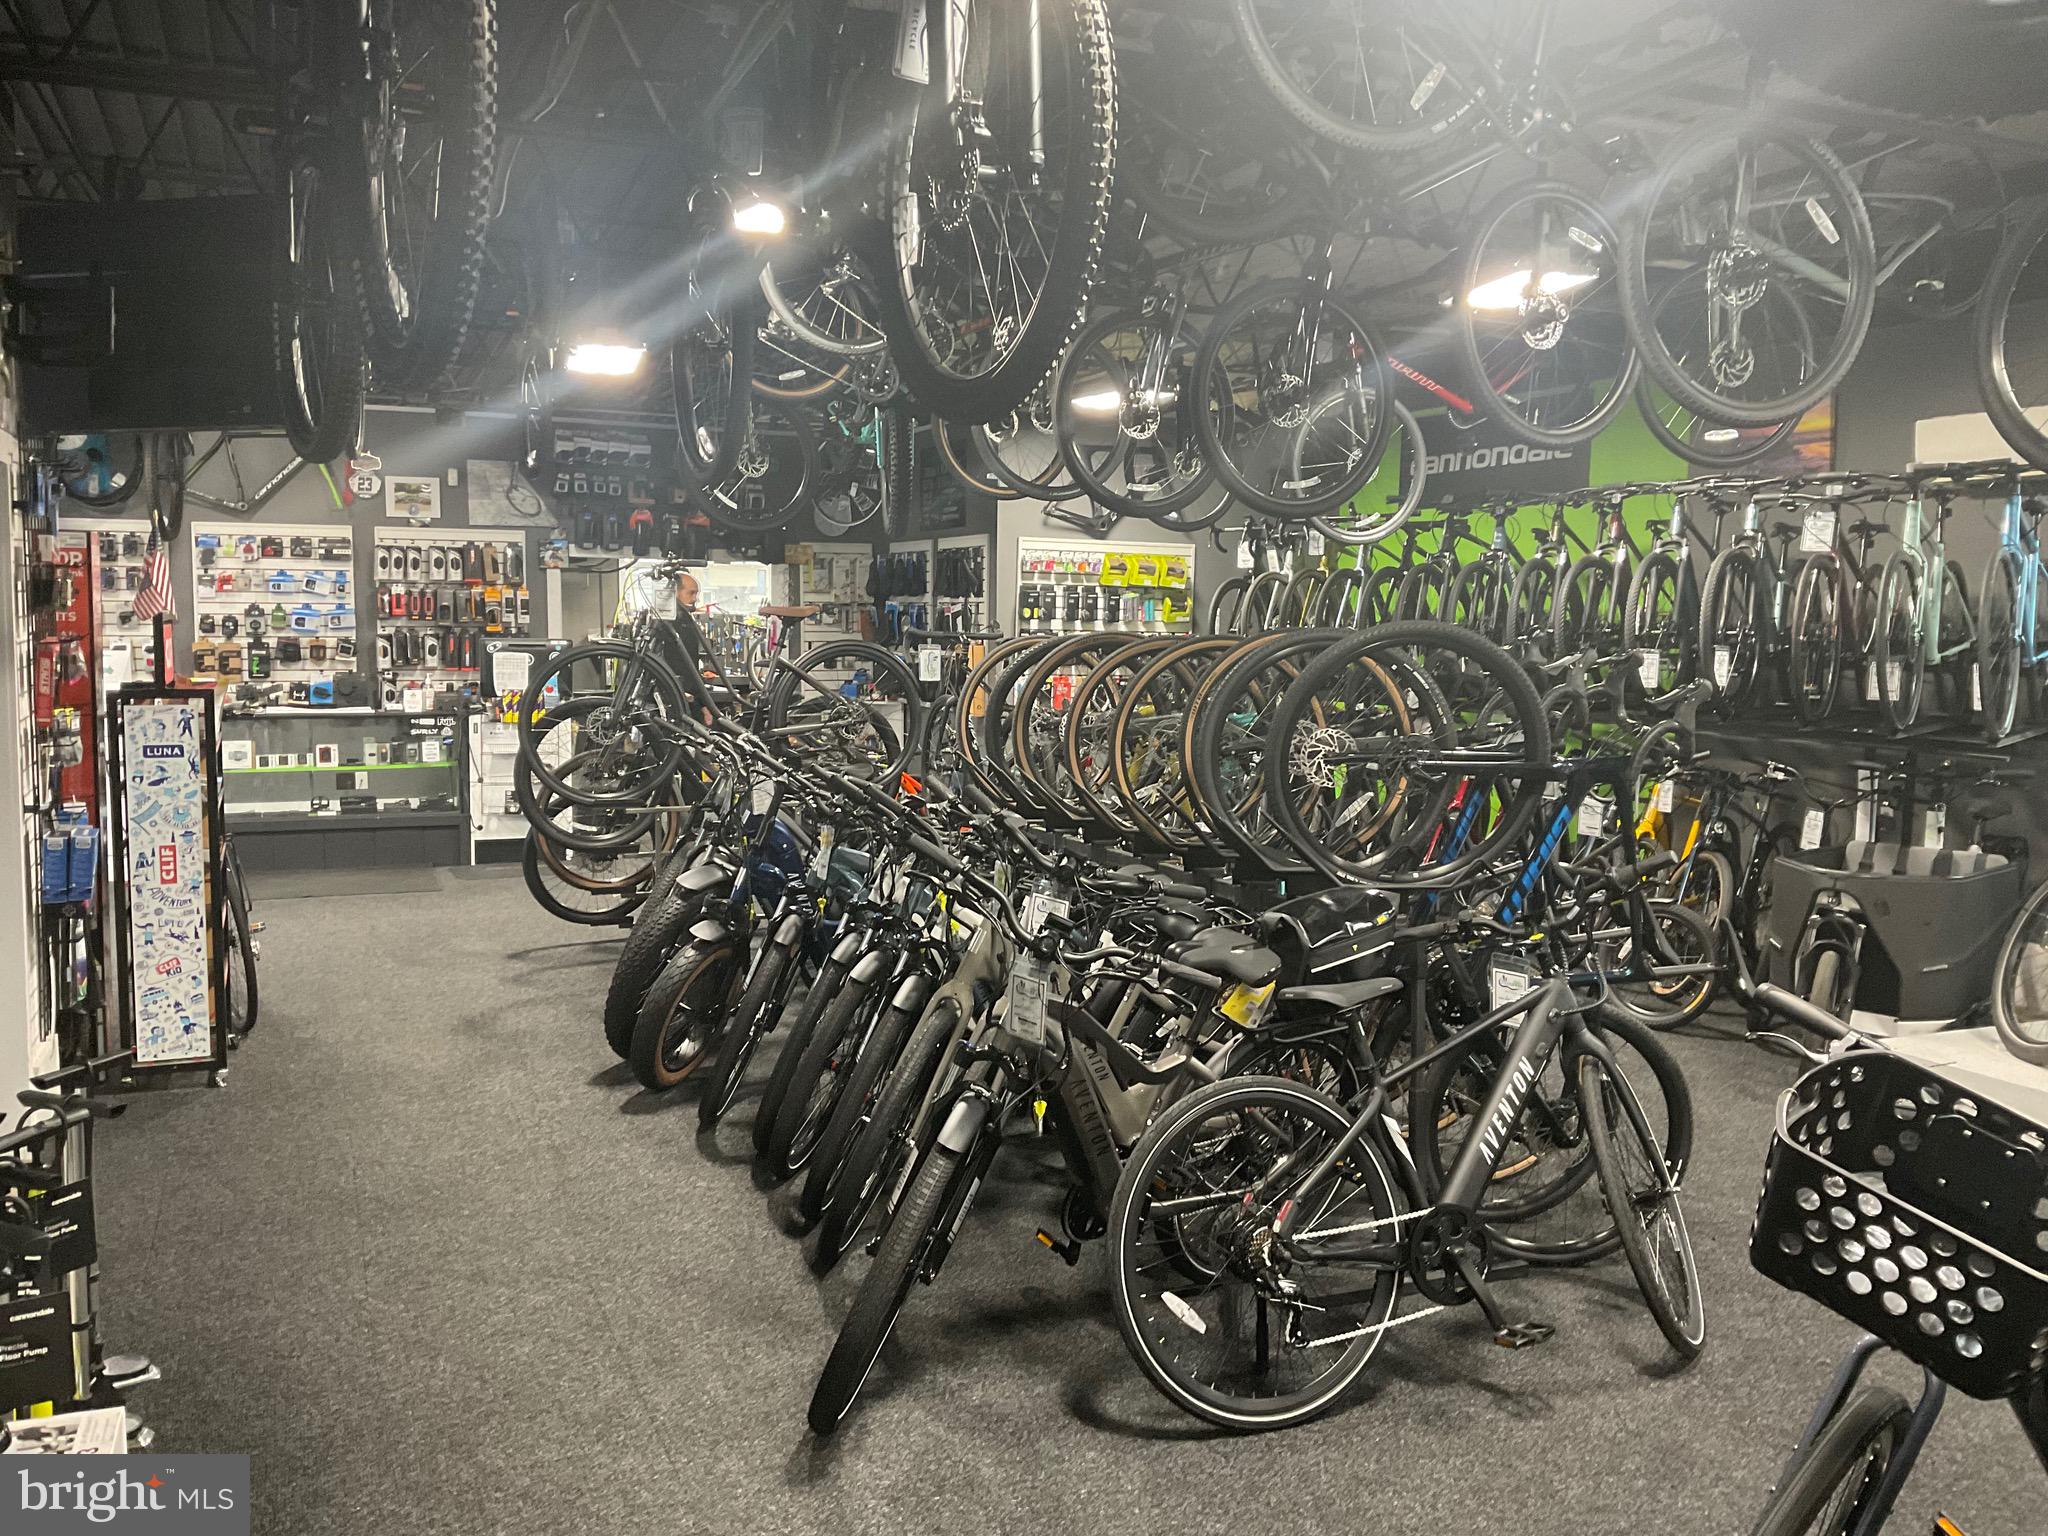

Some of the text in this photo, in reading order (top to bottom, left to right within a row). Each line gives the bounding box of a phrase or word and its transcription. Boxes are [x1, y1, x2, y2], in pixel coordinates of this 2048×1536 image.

[357, 477, 373, 492] 23
[410, 728, 439, 736] SURLY
[146, 747, 182, 756] LUNA
[161, 847, 175, 881] CLIF
[1071, 1078, 1111, 1157] AVENTON
[1479, 1055, 1535, 1166] AVENTON
[9, 1307, 55, 1323] cannondale
[23, 1346, 49, 1358] Pump
